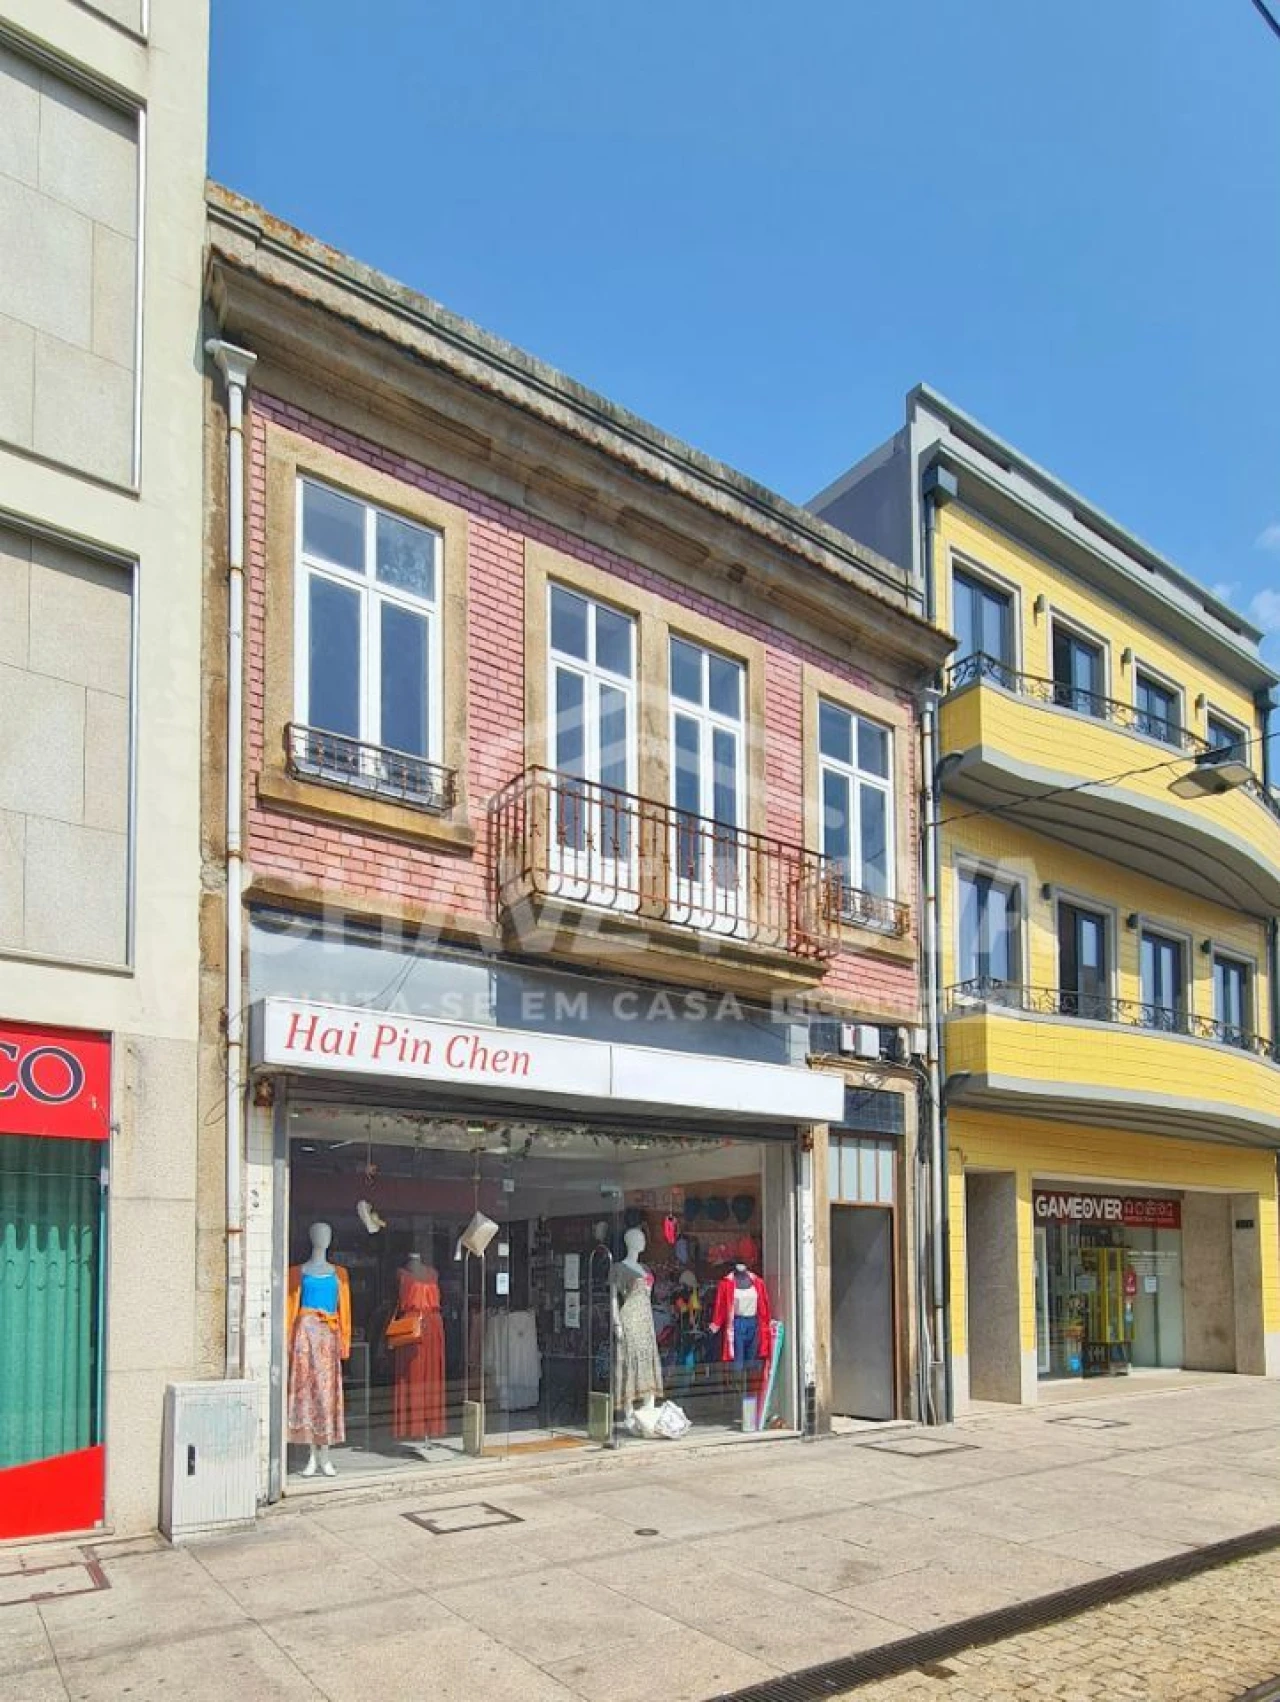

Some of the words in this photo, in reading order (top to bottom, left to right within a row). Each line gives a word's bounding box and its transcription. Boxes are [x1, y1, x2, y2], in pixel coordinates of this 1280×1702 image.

[284, 1011, 360, 1058] Hai
[370, 1024, 431, 1066] Pin
[445, 1034, 531, 1077] Chen
[1035, 1194, 1123, 1221] GAMEOVER
